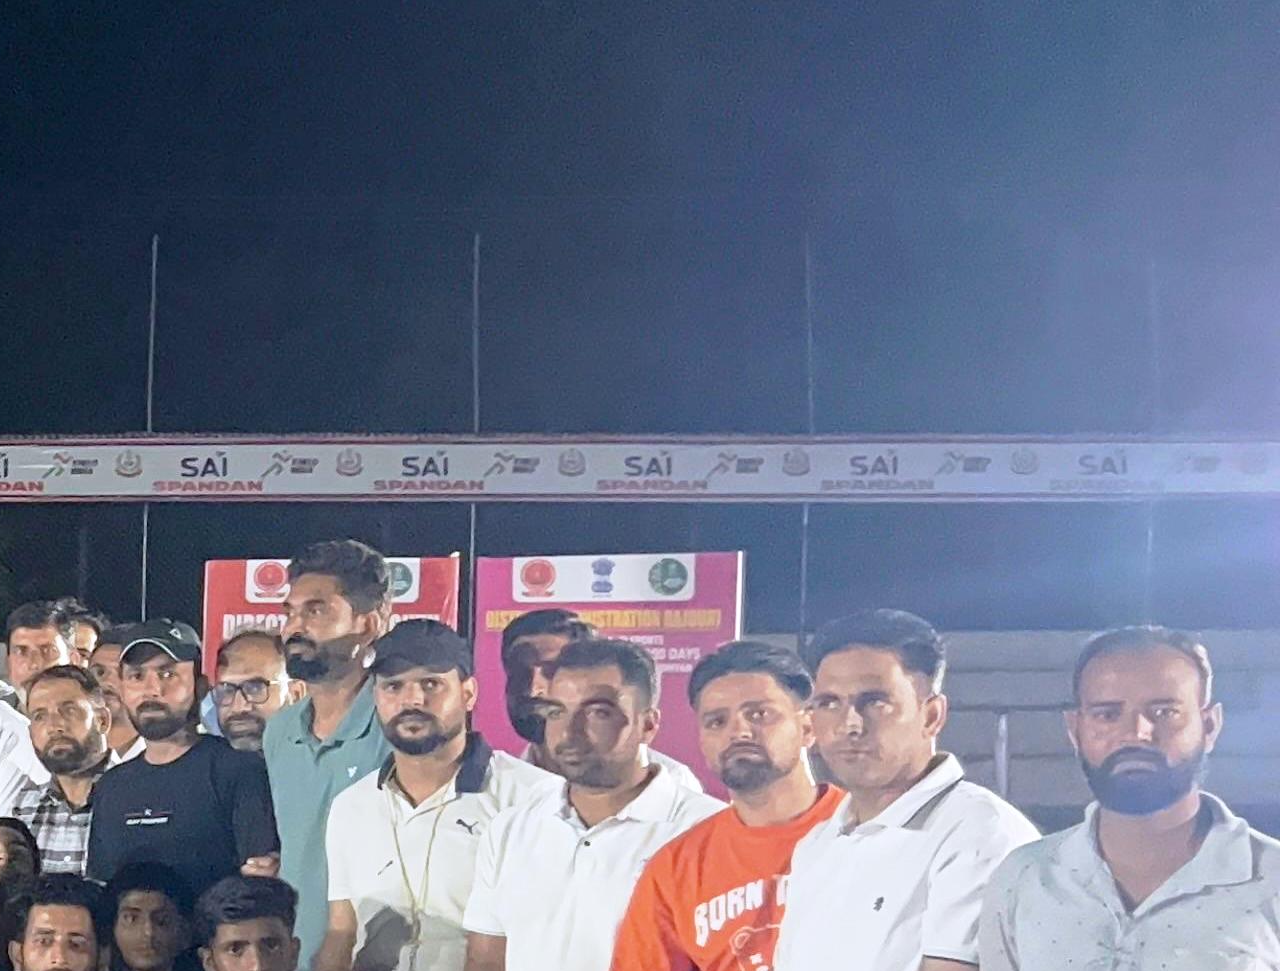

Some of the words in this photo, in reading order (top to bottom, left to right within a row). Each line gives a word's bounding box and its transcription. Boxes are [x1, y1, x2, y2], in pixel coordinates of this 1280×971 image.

[180, 456, 228, 478] SAI
[401, 455, 449, 477] SAI
[152, 480, 263, 492] SPANDAN
[694, 878, 764, 948] BORN
